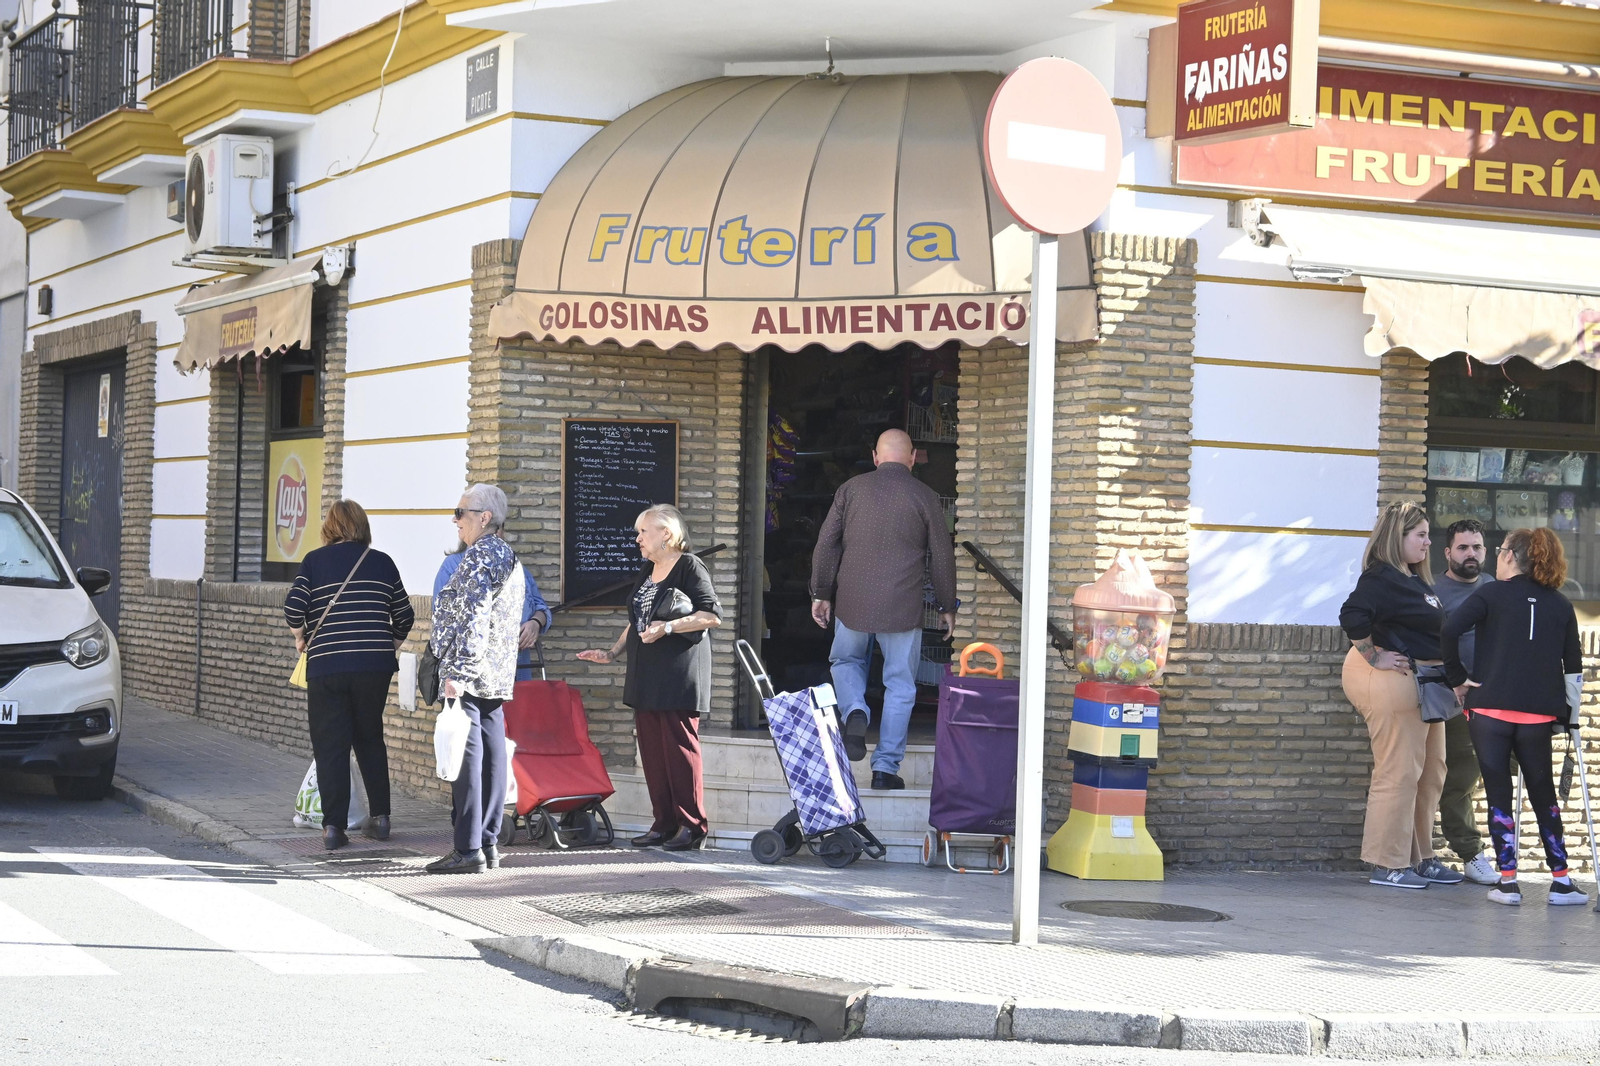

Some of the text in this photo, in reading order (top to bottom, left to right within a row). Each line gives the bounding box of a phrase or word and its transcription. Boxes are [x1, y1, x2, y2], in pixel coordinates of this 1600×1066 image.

[1205, 1, 1267, 41] FRUTERÍA
[476, 53, 494, 72] CALLE
[1184, 43, 1288, 105] FARIÑAS
[471, 90, 492, 114] PICOTE
[1187, 89, 1282, 132] ALIMENTACIÓN
[208, 182, 214, 195] LG
[1315, 145, 1600, 201] FRUTERÍA
[588, 213, 960, 267] Frutería
[538, 301, 709, 333] GOLOSINAS
[277, 479, 305, 540] Lay's
[2, 704, 12, 721] M
